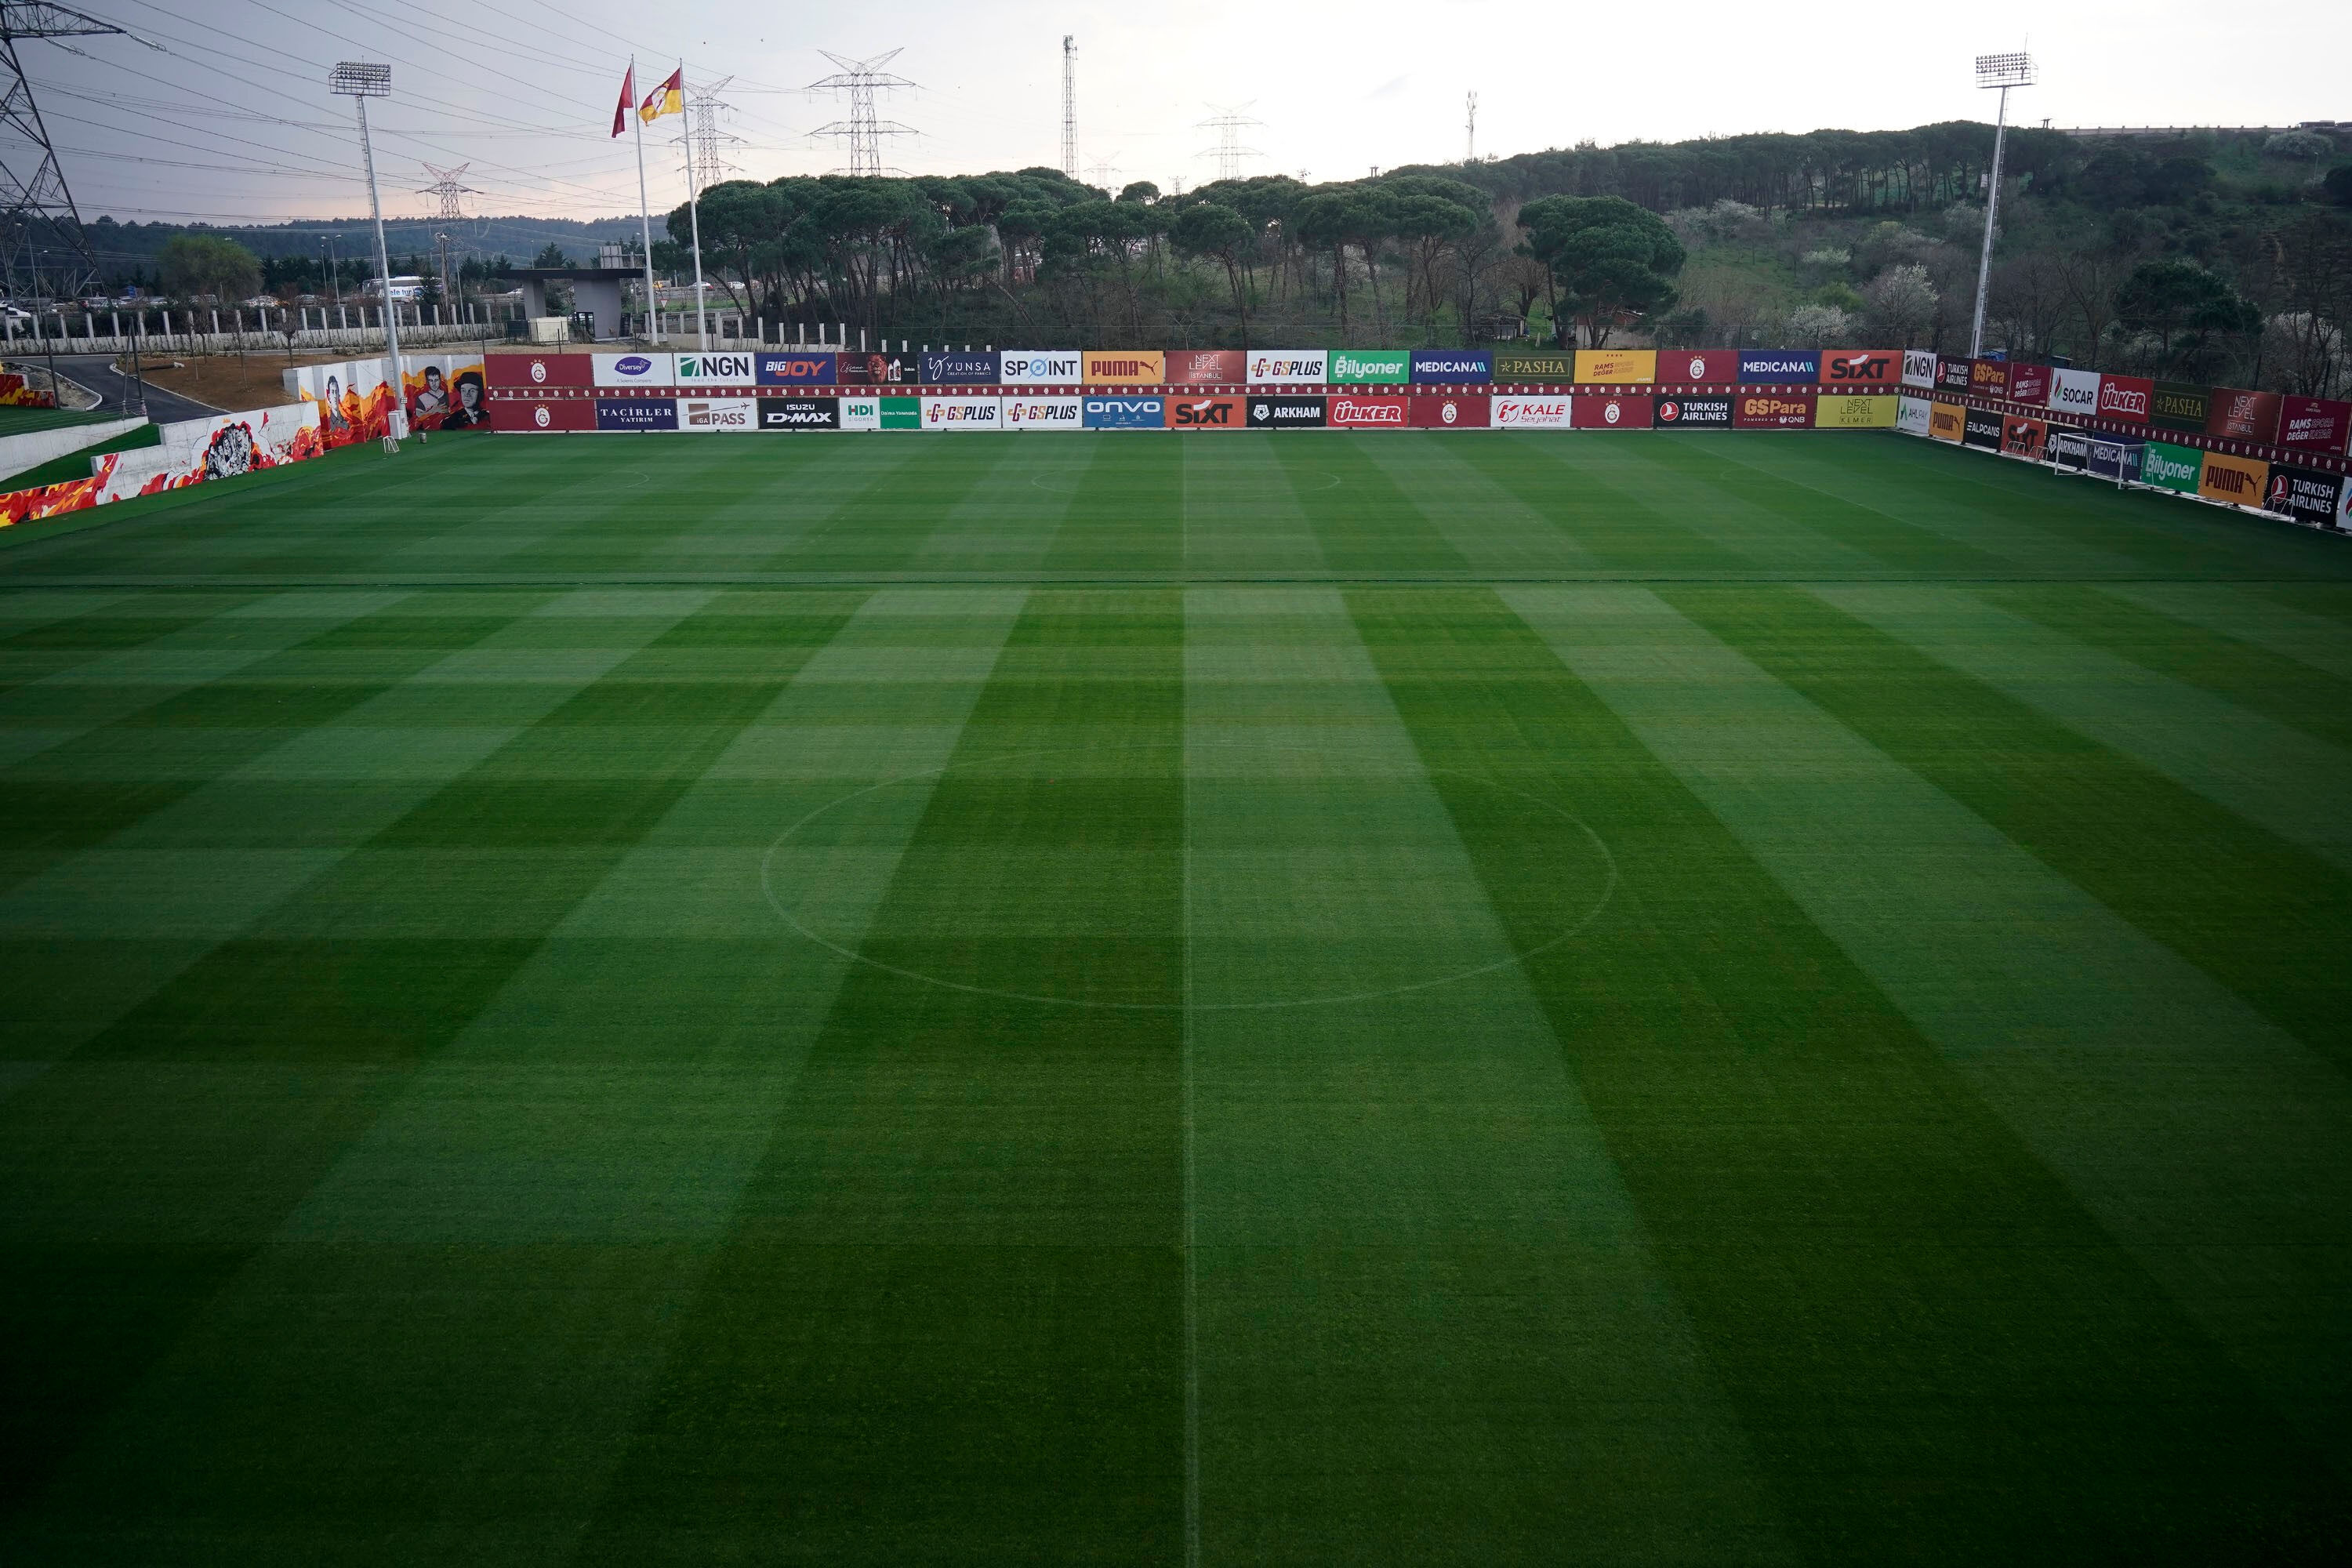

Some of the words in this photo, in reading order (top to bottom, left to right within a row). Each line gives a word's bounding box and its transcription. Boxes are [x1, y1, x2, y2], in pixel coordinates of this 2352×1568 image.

[702, 357, 750, 376] NGN
[1091, 361, 1138, 376] PUMA
[1189, 361, 1222, 370] LEVEL
[1272, 361, 1323, 376] GSPLUS
[1334, 356, 1403, 379] Bilyoner
[1415, 361, 1478, 372] MEDICANA
[1513, 361, 1566, 373] PASHA
[1595, 362, 1614, 371] RAMS
[1743, 361, 1806, 372] MEDICANA
[1914, 356, 1934, 378] NGN
[1947, 363, 1969, 376] TURKISH
[1946, 374, 1968, 386] AIRLINES
[1973, 363, 2005, 384] GSPara
[2015, 380, 2029, 390] RAMS
[2062, 387, 2093, 405] SOCAR
[2101, 382, 2146, 415] ÜLKER
[2234, 395, 2257, 408] NEXT
[601, 407, 672, 416] TACİRLER
[848, 405, 873, 416] HDI
[947, 406, 996, 420] GSPLUS
[1028, 405, 1077, 419] GSPLUS
[1274, 407, 1320, 418] ARKHAM
[1334, 401, 1402, 423] ÜLKER
[1523, 405, 1566, 415] KALE
[1683, 402, 1728, 412] TURKISH
[1744, 398, 1806, 415] GSPara
[1840, 405, 1873, 414] LEVEL
[2165, 396, 2202, 417] PASHA
[2228, 407, 2256, 420] LEVEL
[712, 412, 746, 424] PASS
[1682, 412, 1728, 421] AIRLINES
[1933, 412, 1954, 431] PUMA
[1972, 422, 2000, 437] ALPCANS
[2289, 418, 2312, 430] RAMS
[2286, 430, 2309, 441] DEĞER
[2058, 439, 2086, 456] ARKHAM
[2093, 445, 2132, 466] MEDICANA
[2146, 449, 2196, 481] Bilyoner
[2205, 465, 2245, 494] PUMA
[2292, 478, 2335, 499] TURKISH
[2289, 493, 2332, 514] AIRLINES
